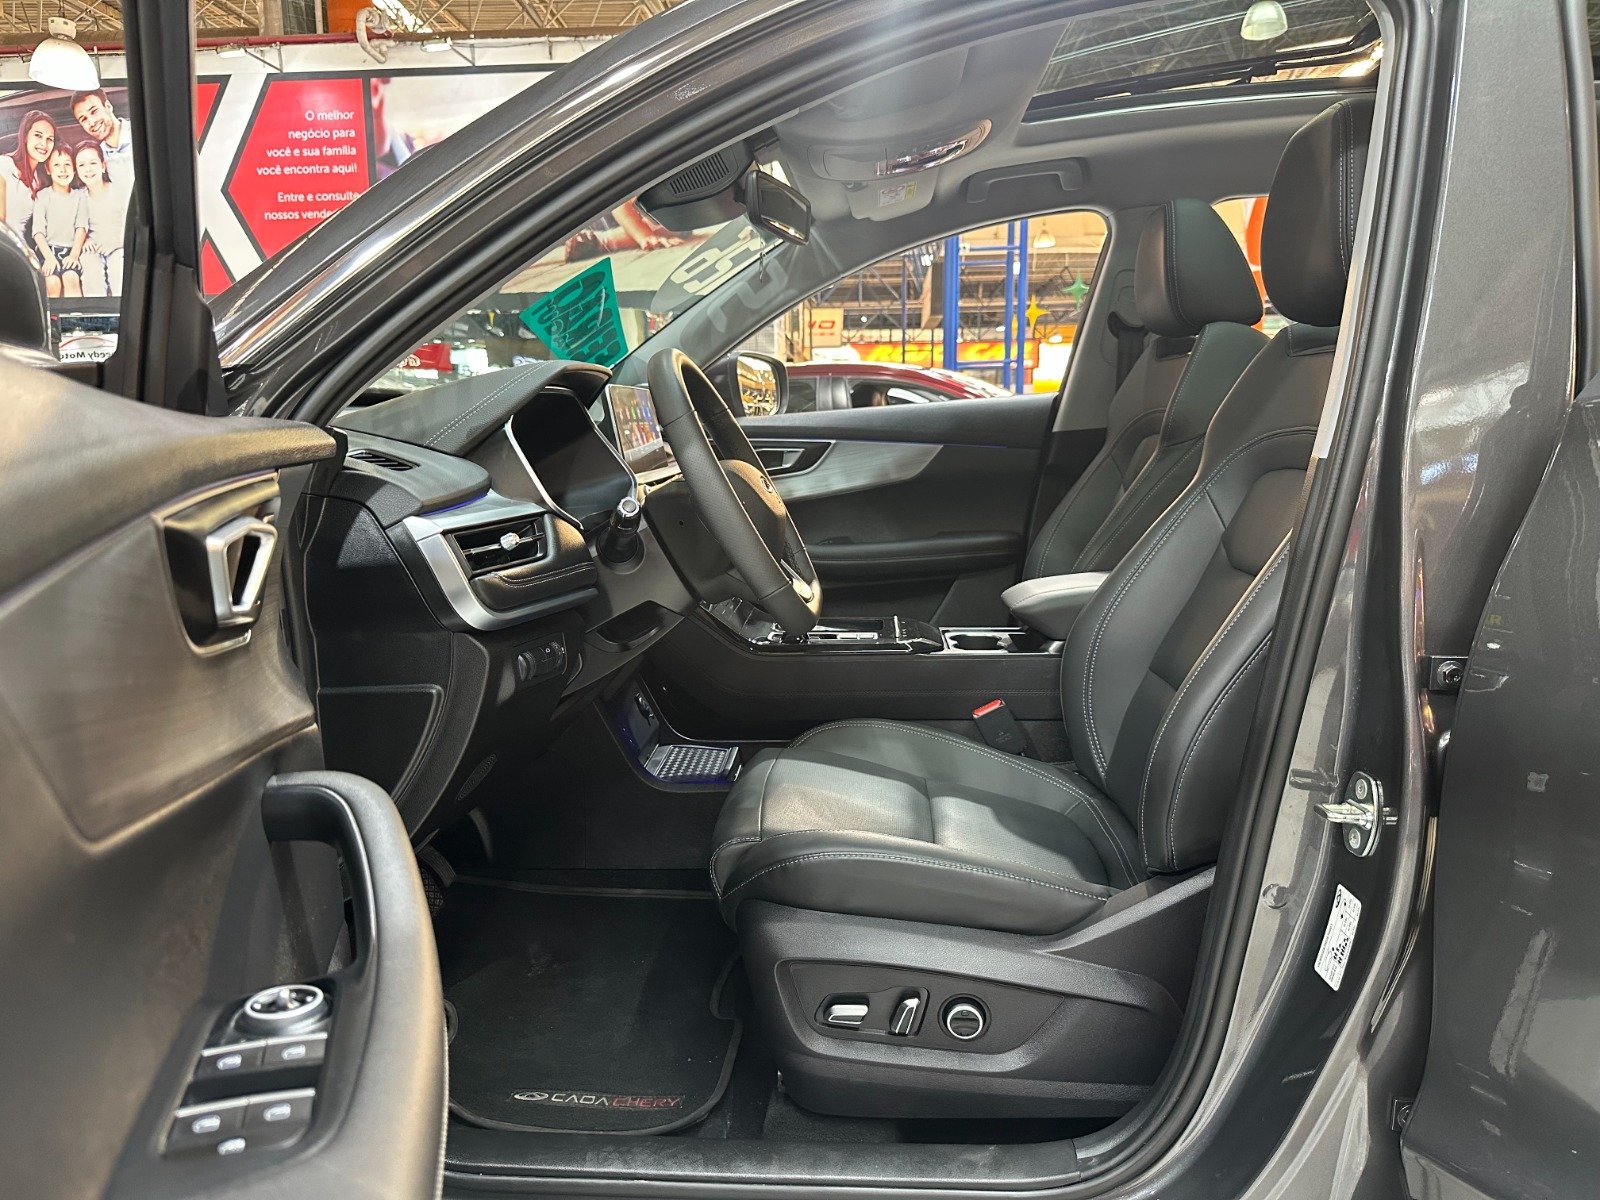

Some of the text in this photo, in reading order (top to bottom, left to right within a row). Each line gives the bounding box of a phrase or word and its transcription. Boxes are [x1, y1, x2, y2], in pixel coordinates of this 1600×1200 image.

[305, 110, 354, 121] O melhor
[288, 129, 356, 141] negócio para
[266, 146, 291, 157] você
[293, 149, 300, 157] e
[303, 148, 320, 157] sua
[256, 163, 358, 176] você encontra aqui!
[277, 191, 360, 202] Entre e consulte
[264, 211, 299, 220] nossos
